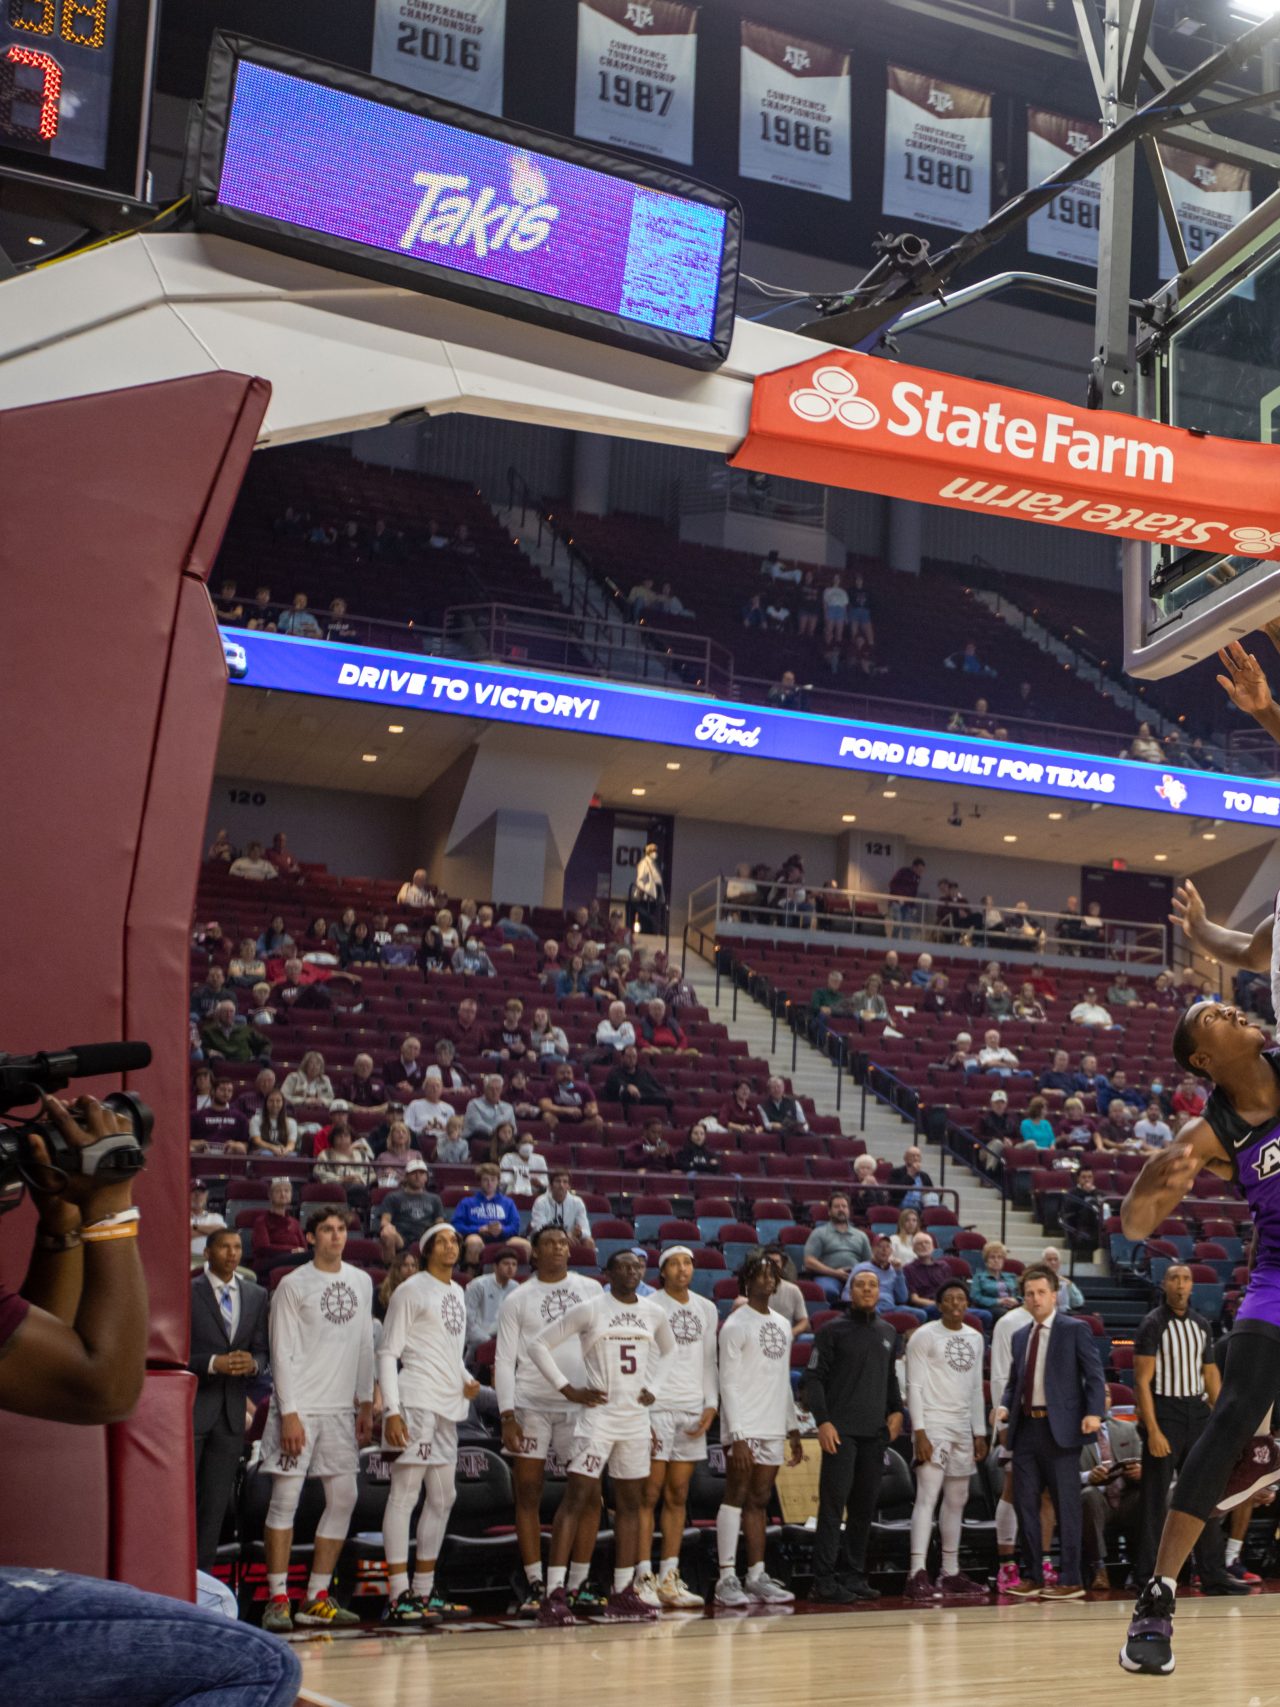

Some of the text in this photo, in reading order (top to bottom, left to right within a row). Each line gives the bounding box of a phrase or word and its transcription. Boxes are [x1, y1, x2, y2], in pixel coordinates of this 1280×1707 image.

[399, 6, 485, 36] CHAMPIONSHIP
[396, 21, 482, 73] 2016
[609, 39, 668, 61] CONFERENCE
[598, 55, 677, 84] CHAMPIONSHIP
[597, 70, 676, 118] 1987
[760, 97, 833, 124] CHAMPIONSHIP
[766, 88, 828, 113] CONFERENCE
[759, 111, 834, 156] 1986
[903, 151, 975, 195] 1980
[399, 170, 560, 258] Takis
[1047, 195, 1100, 231] 198
[338, 663, 428, 696] DRIVE
[430, 676, 470, 701] TO
[694, 712, 761, 749] Ford
[839, 736, 1116, 794] FORD IS BUILT FOR TEXAS
[228, 790, 267, 806] 120
[1222, 789, 1252, 812] TO
[1251, 797, 1280, 816] BE
[865, 842, 892, 856] 121
[620, 1344, 637, 1375] 5
